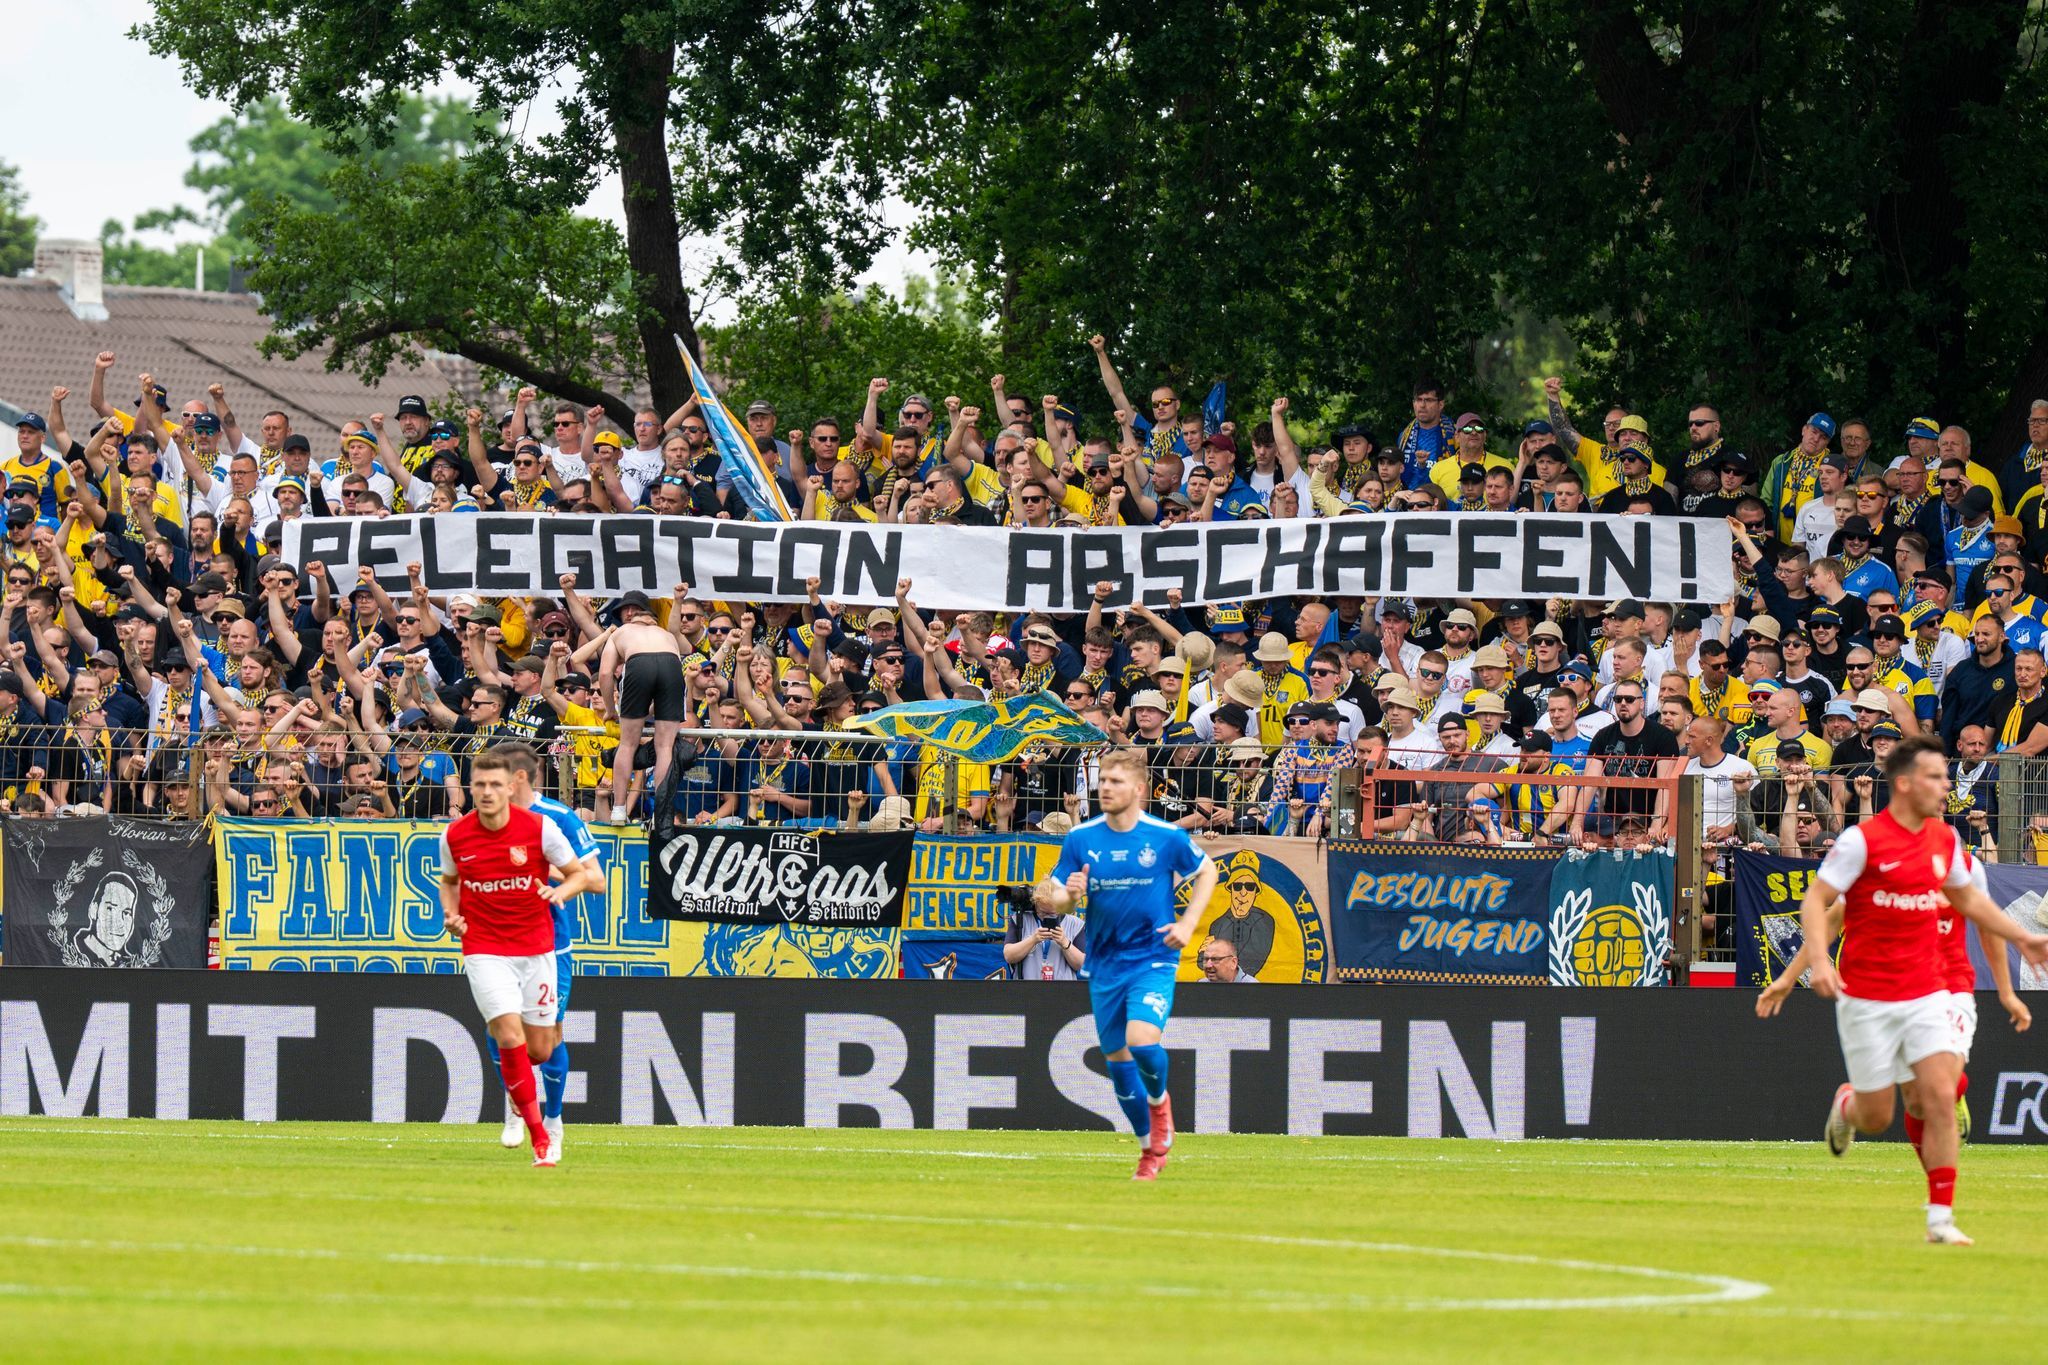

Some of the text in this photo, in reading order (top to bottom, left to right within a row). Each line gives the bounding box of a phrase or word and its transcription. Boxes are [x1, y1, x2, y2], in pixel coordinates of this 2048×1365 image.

[300, 516, 1697, 608] RELEGATION ABSCHAFFEN!
[107, 820, 167, 841] Florian
[778, 835, 811, 851] HFC
[911, 843, 1037, 882] TIFOSI IN
[224, 830, 670, 948] FANSNE
[681, 893, 761, 916] Saalefront
[908, 888, 1005, 930] PENSIO
[1346, 870, 1513, 913] RESOLUTE
[1398, 914, 1545, 957] JUGEND
[0, 1000, 316, 1121] MIT
